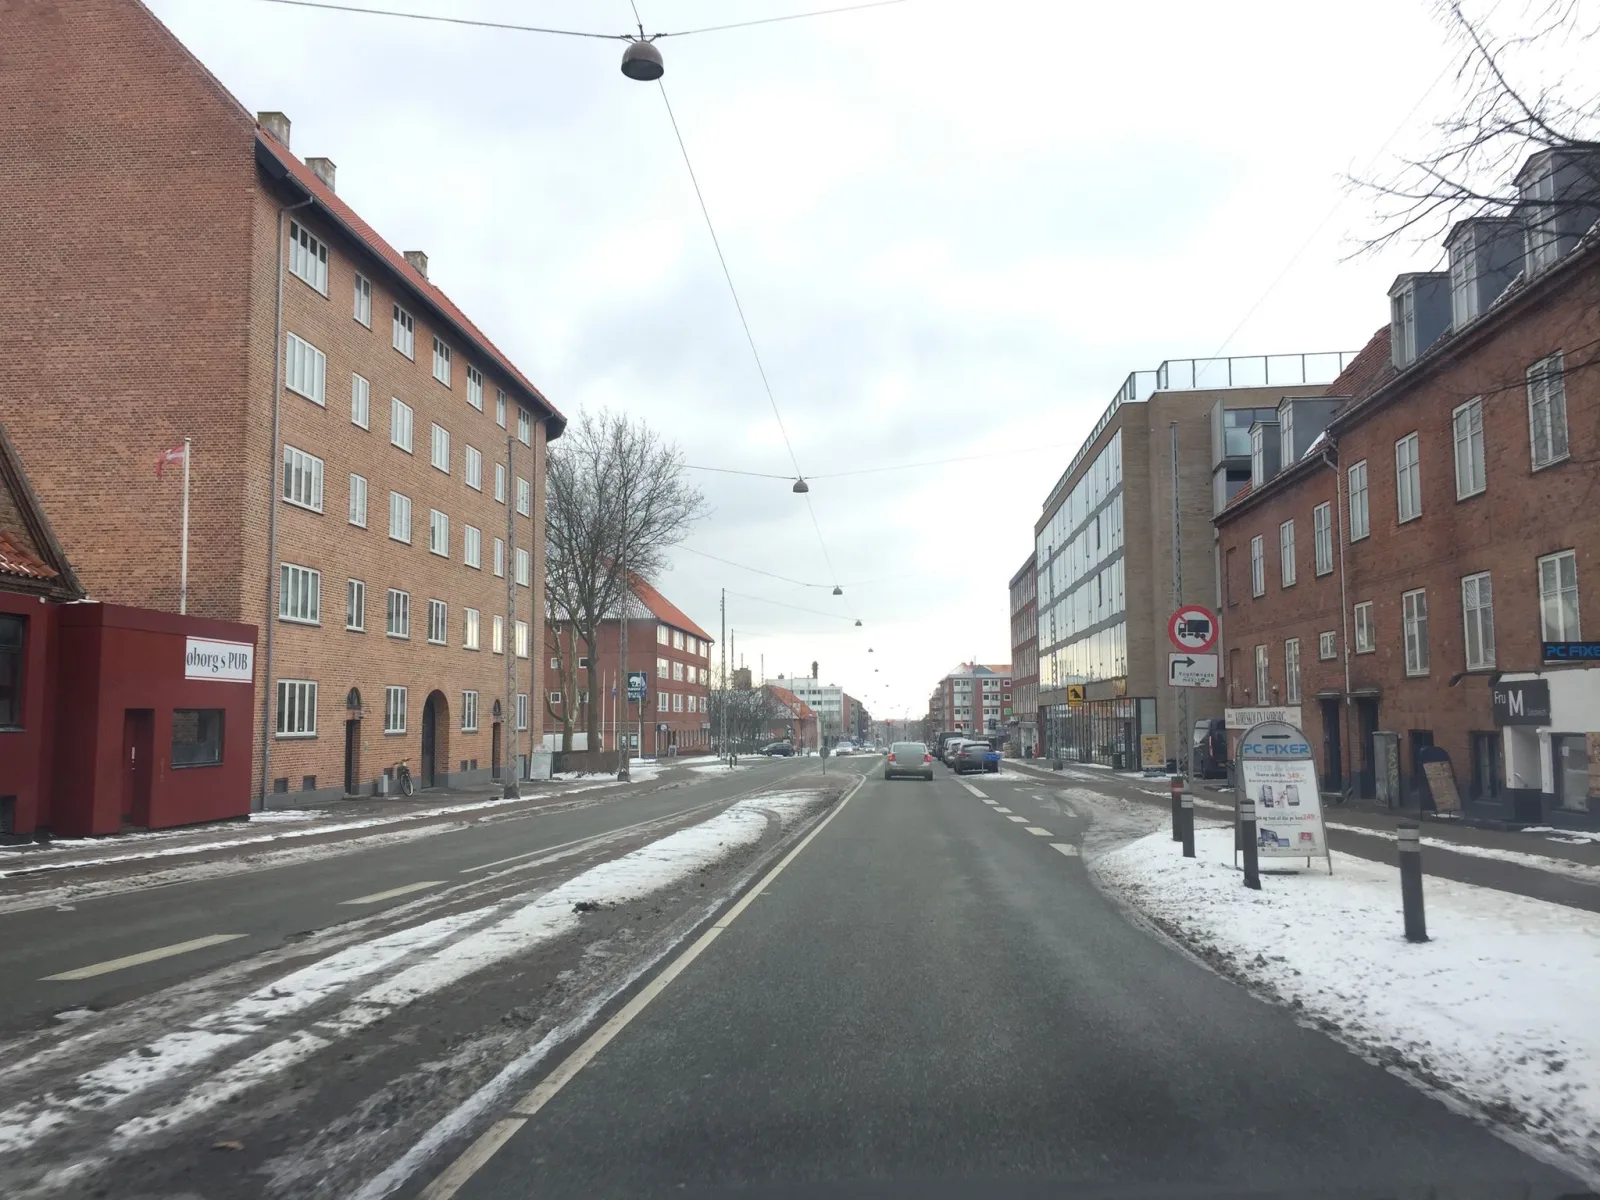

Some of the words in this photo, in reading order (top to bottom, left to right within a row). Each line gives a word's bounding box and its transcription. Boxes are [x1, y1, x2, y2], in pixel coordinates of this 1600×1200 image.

[1547, 645, 1567, 657] PC
[228, 652, 248, 670] PUB
[1494, 691, 1506, 704] Fru
[1508, 690, 1524, 716] M
[1243, 743, 1263, 755] PC
[1265, 743, 1309, 755] FIXER
